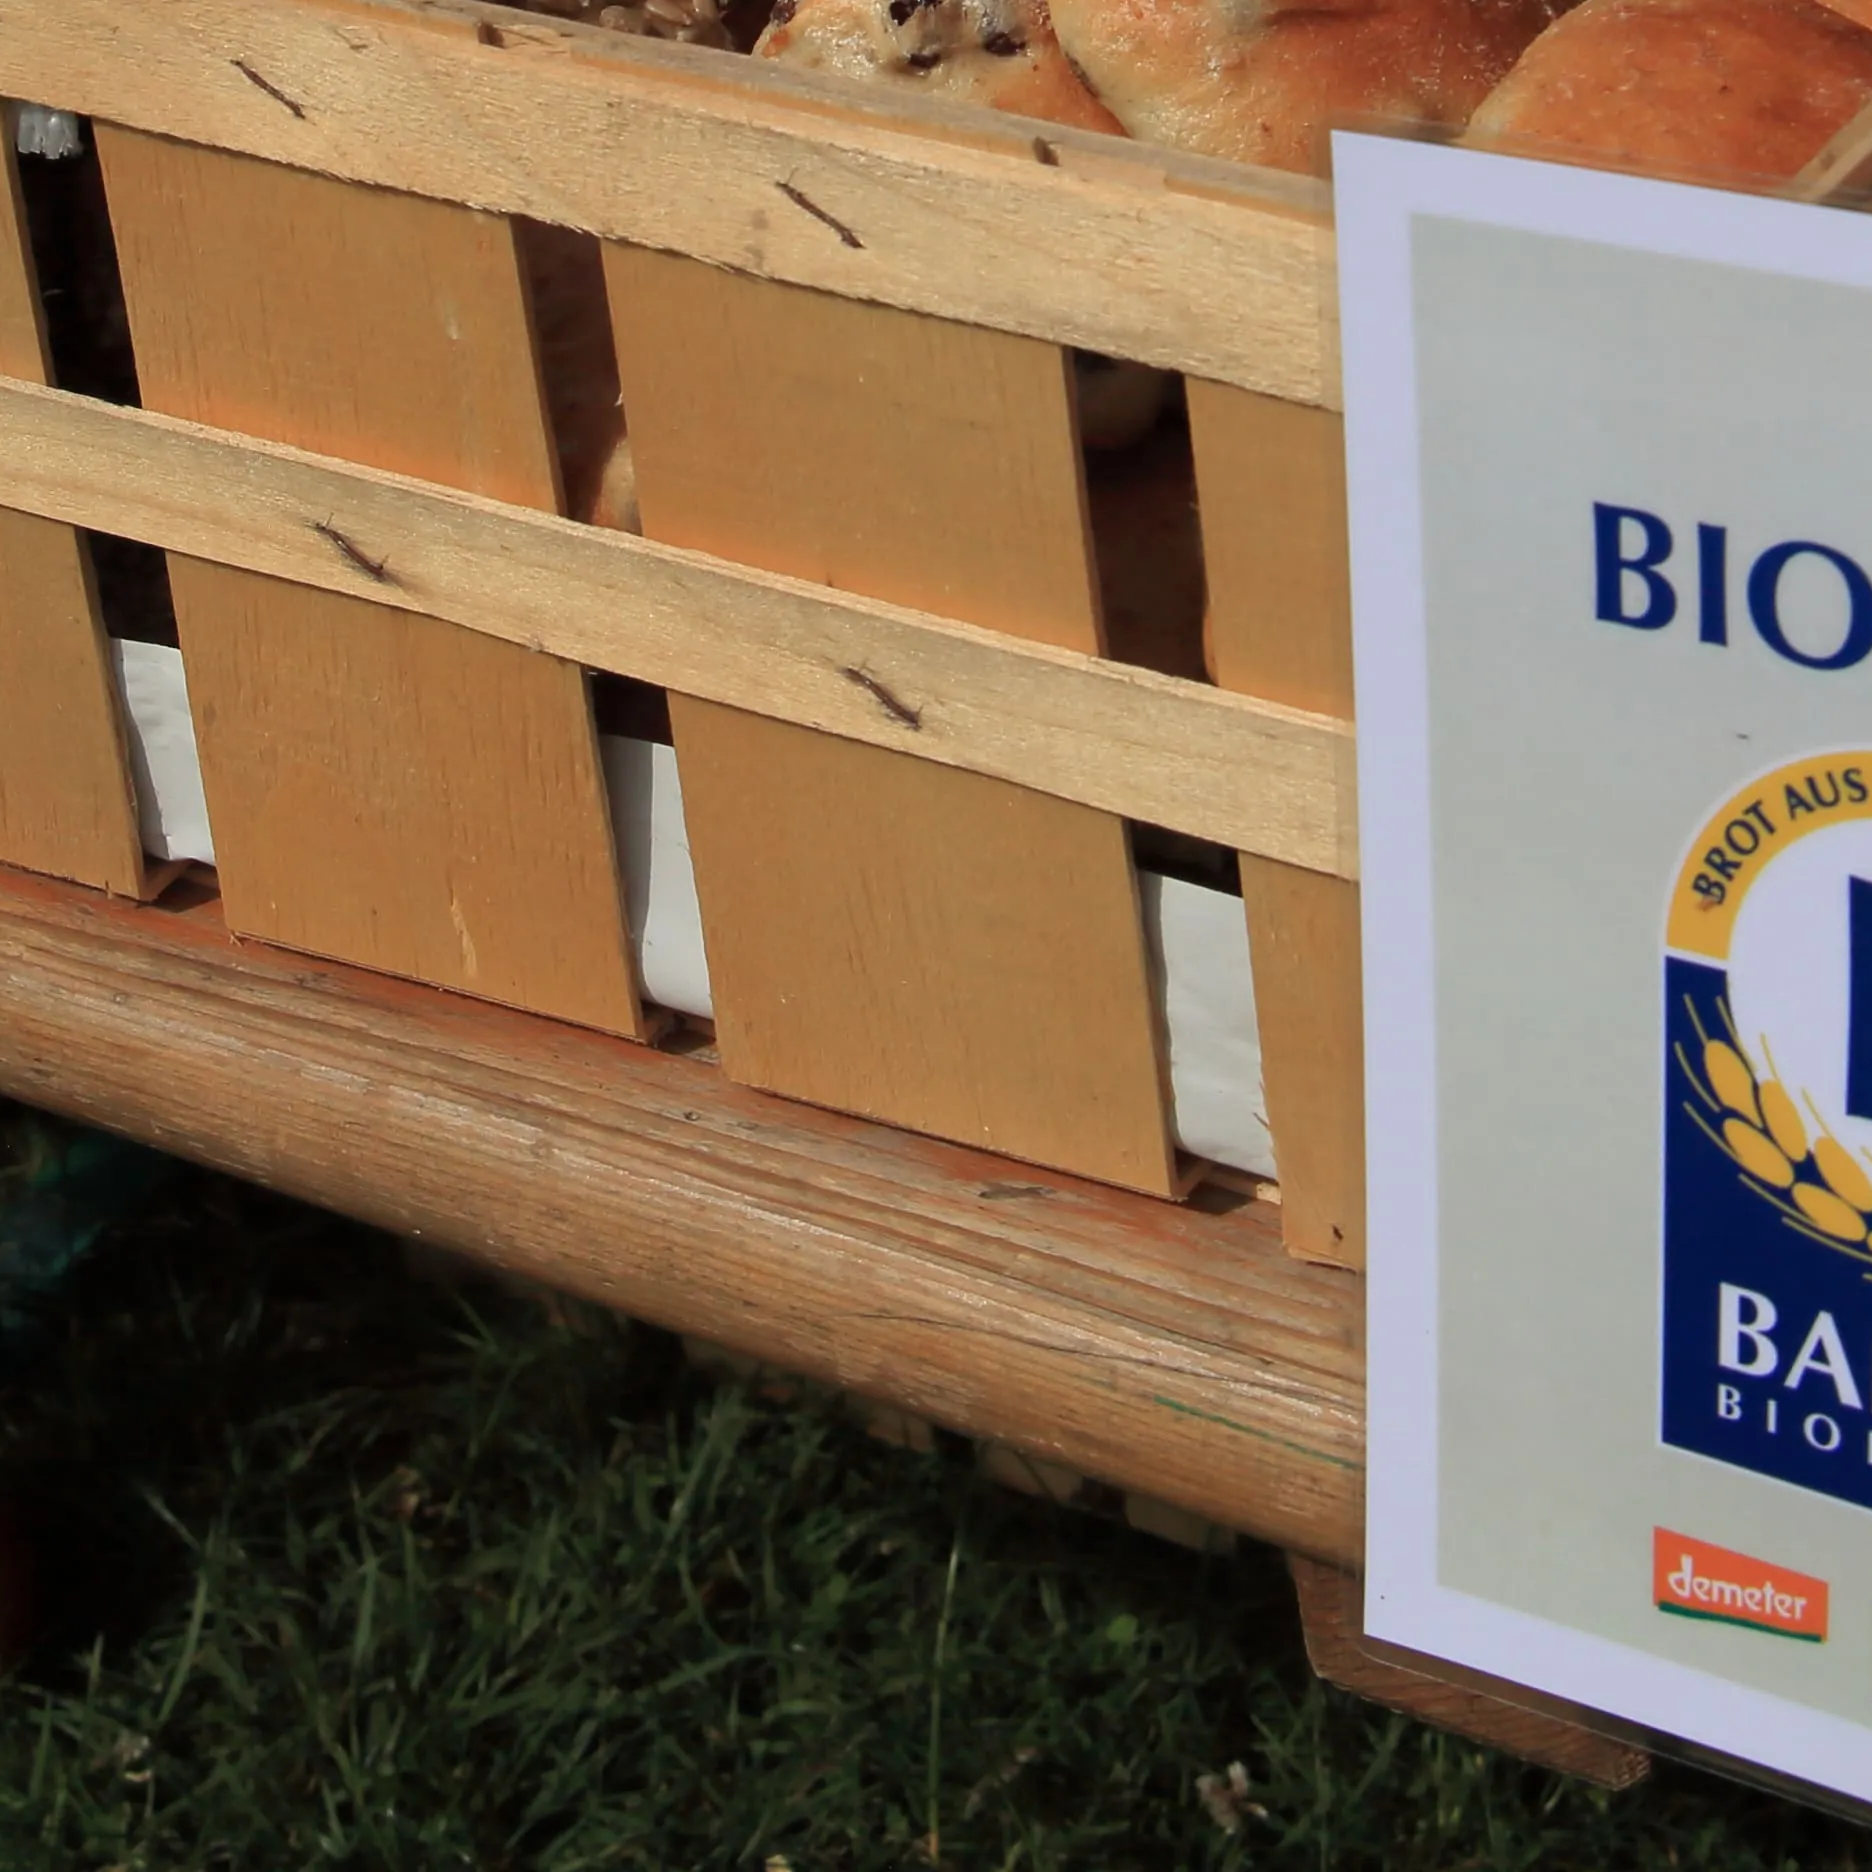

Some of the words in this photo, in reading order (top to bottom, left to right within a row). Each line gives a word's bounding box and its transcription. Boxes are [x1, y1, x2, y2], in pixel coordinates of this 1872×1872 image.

[1691, 800, 1778, 907] BROT
[1784, 766, 1870, 820] AUS
[1667, 1556, 1809, 1622] demeter
